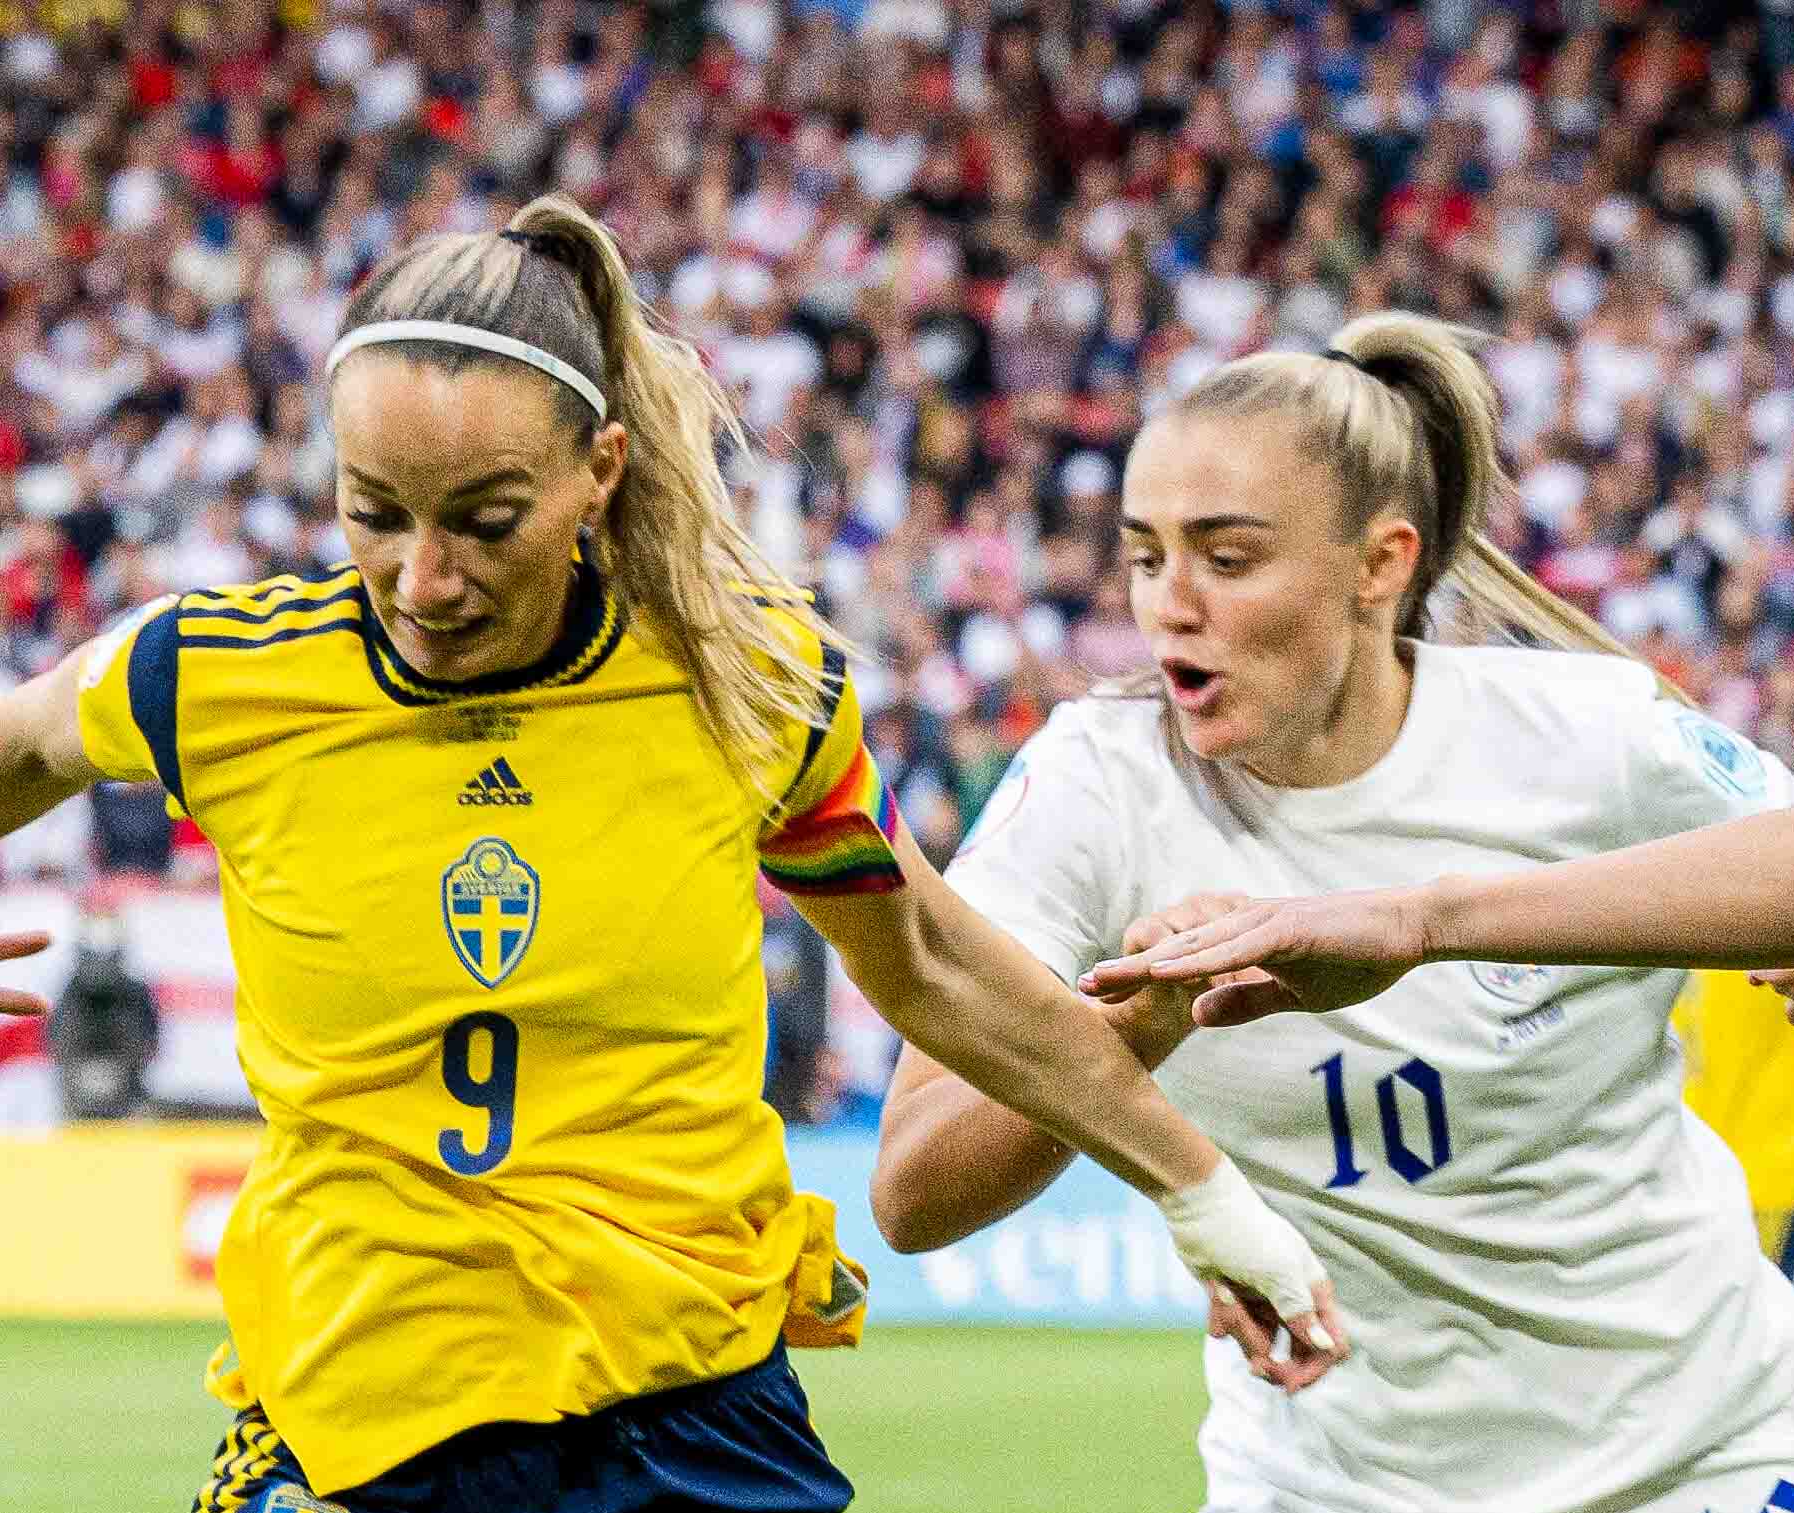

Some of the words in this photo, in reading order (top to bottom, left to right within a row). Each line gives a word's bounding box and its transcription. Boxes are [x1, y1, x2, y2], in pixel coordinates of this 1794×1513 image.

[457, 787, 534, 807] adidas
[438, 1010, 519, 1177] 9
[1310, 1049, 1452, 1190] 10
